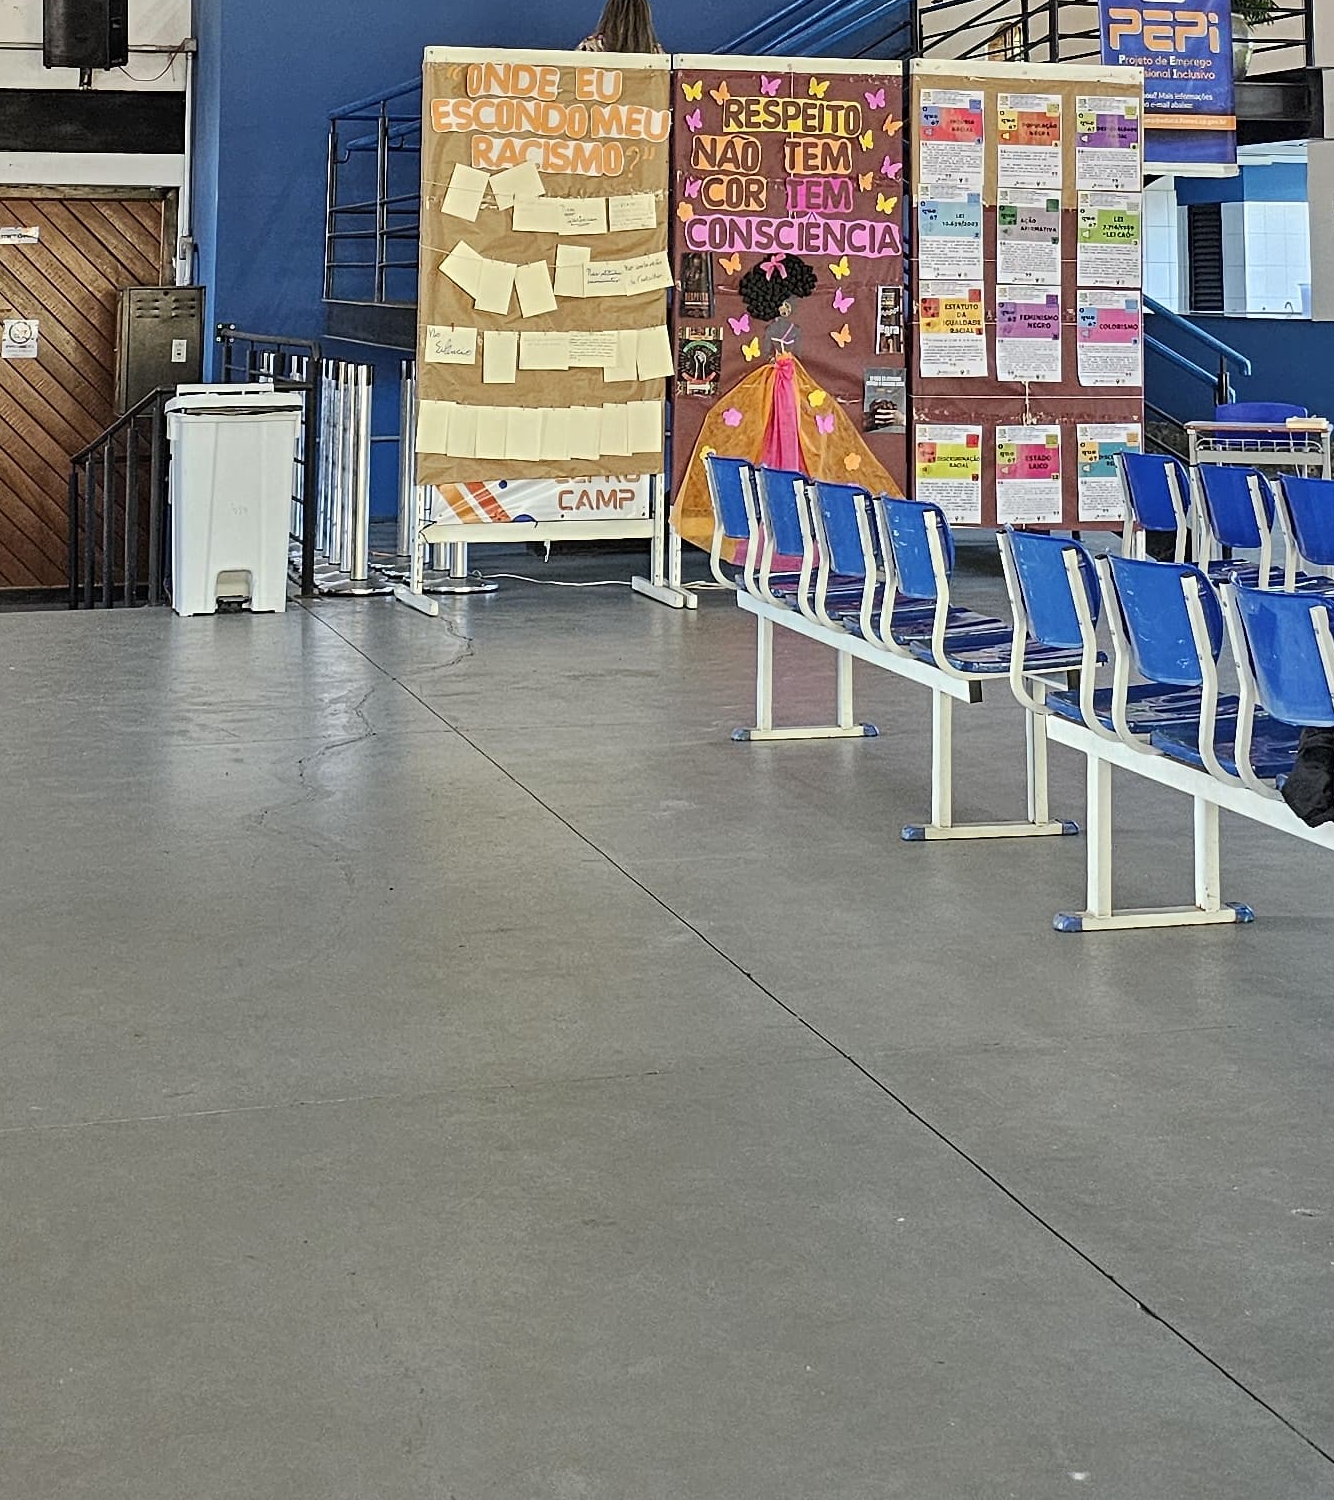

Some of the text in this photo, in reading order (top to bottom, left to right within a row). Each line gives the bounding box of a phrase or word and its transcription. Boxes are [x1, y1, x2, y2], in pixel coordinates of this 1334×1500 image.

[1119, 55, 1212, 69] Projeto de Emprego
[1173, 69, 1216, 80] Inclusivo
[576, 68, 623, 102] EU
[432, 99, 671, 142] ESCONDO MEU
[724, 98, 861, 134] RESPEITO
[692, 134, 852, 171] NÃO TEM
[702, 177, 853, 210] COR TEM
[686, 211, 900, 254] CONSCIÊNCIA
[1020, 217, 1037, 225] AÇÃO
[557, 489, 636, 510] CAMP
